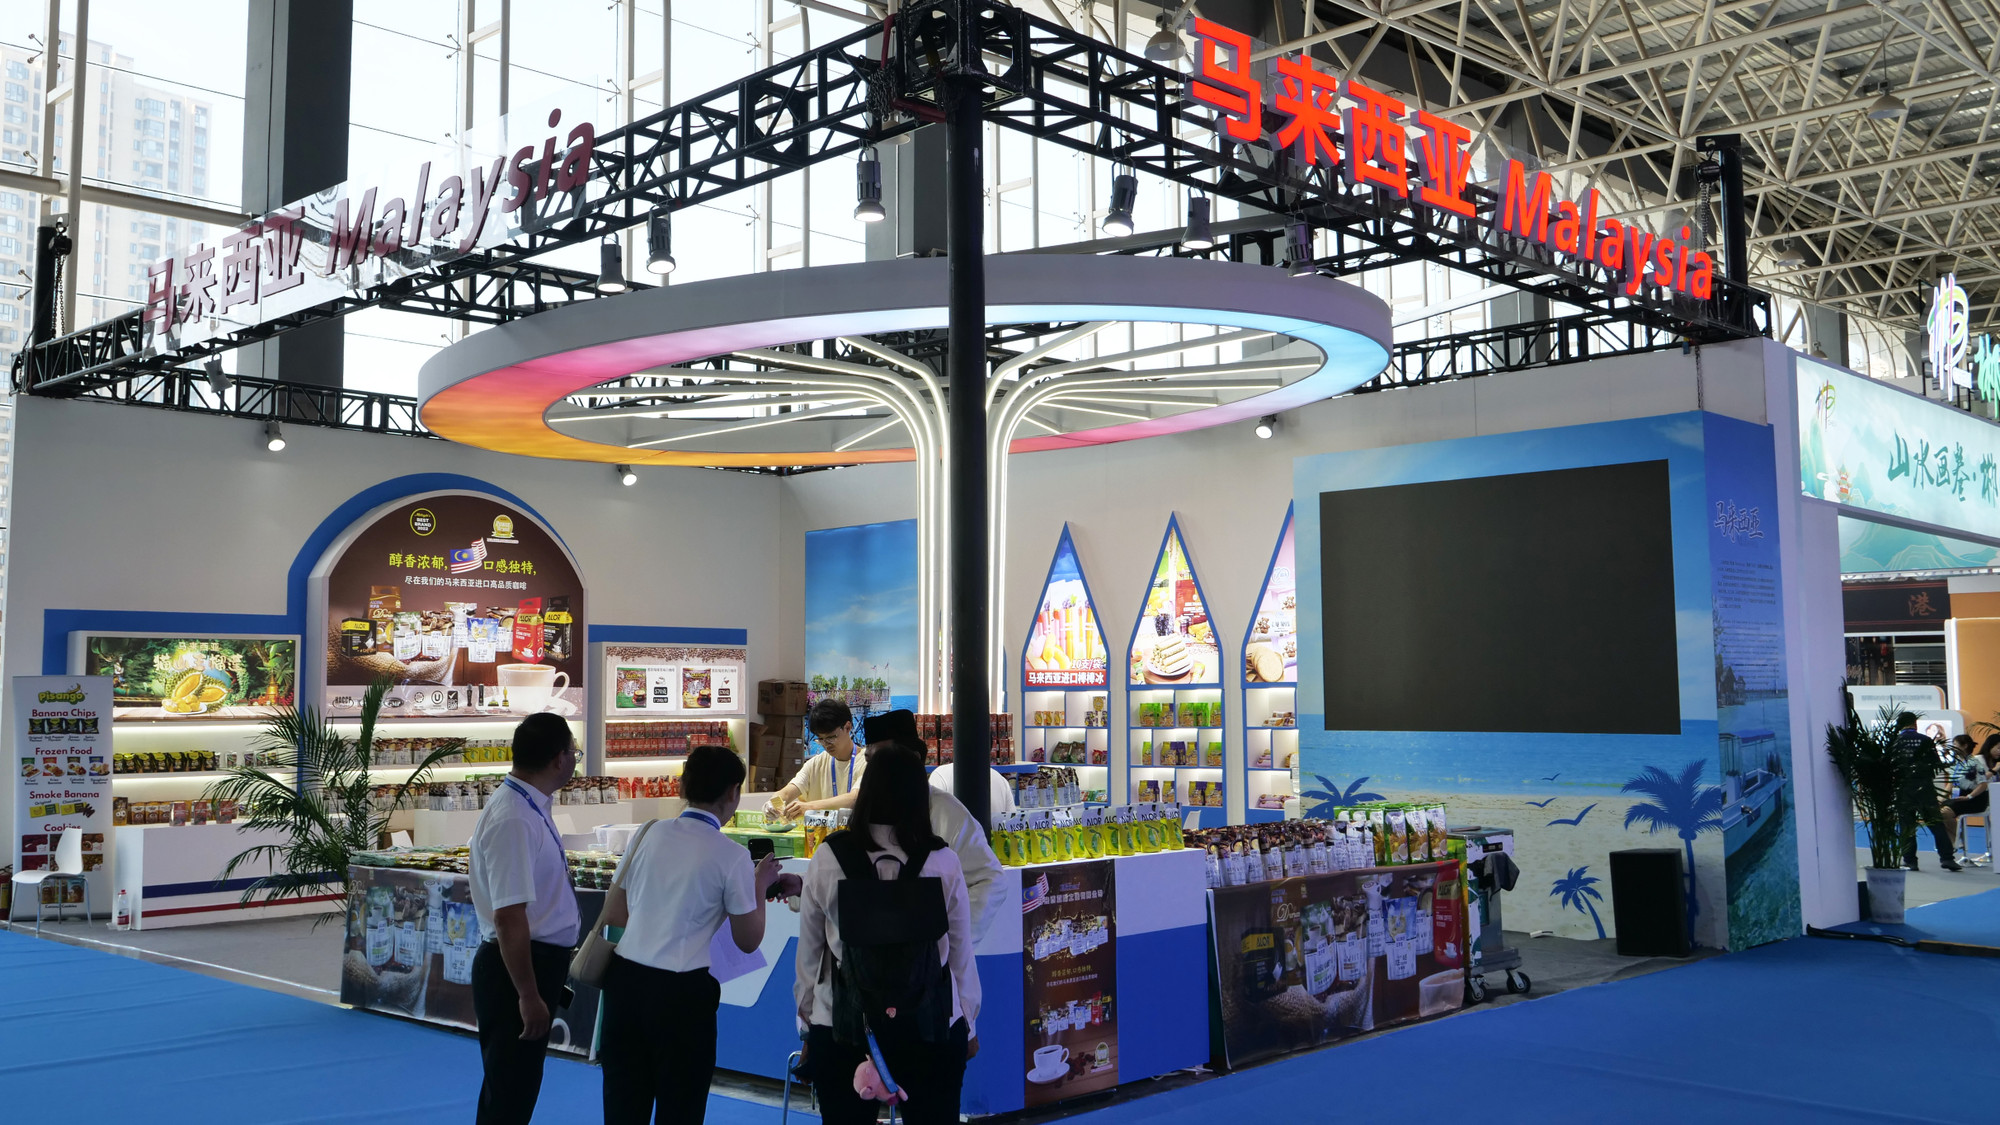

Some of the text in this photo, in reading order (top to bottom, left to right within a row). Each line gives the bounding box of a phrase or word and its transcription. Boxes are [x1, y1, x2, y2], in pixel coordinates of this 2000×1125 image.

[1186, 17, 1713, 300] 马来西亚 Malaysia
[143, 108, 596, 335] 马来西亚 Malaysia
[1907, 591, 1937, 617] 港
[546, 613, 561, 622] ALOR
[178, 641, 221, 652] 马来西亚
[153, 652, 244, 672] 猫山王榴莲
[1027, 671, 1105, 685] 马来西亚进口棒棒冰
[38, 691, 85, 705] Pisango
[32, 708, 97, 719] Banana Chips
[35, 746, 93, 756] Frozen Food
[29, 789, 100, 799] Smoke Banana
[1086, 817, 1102, 826] ALOR
[1104, 815, 1117, 824] ALO
[1141, 812, 1158, 822] ALOR
[1034, 820, 1050, 830] ALOR
